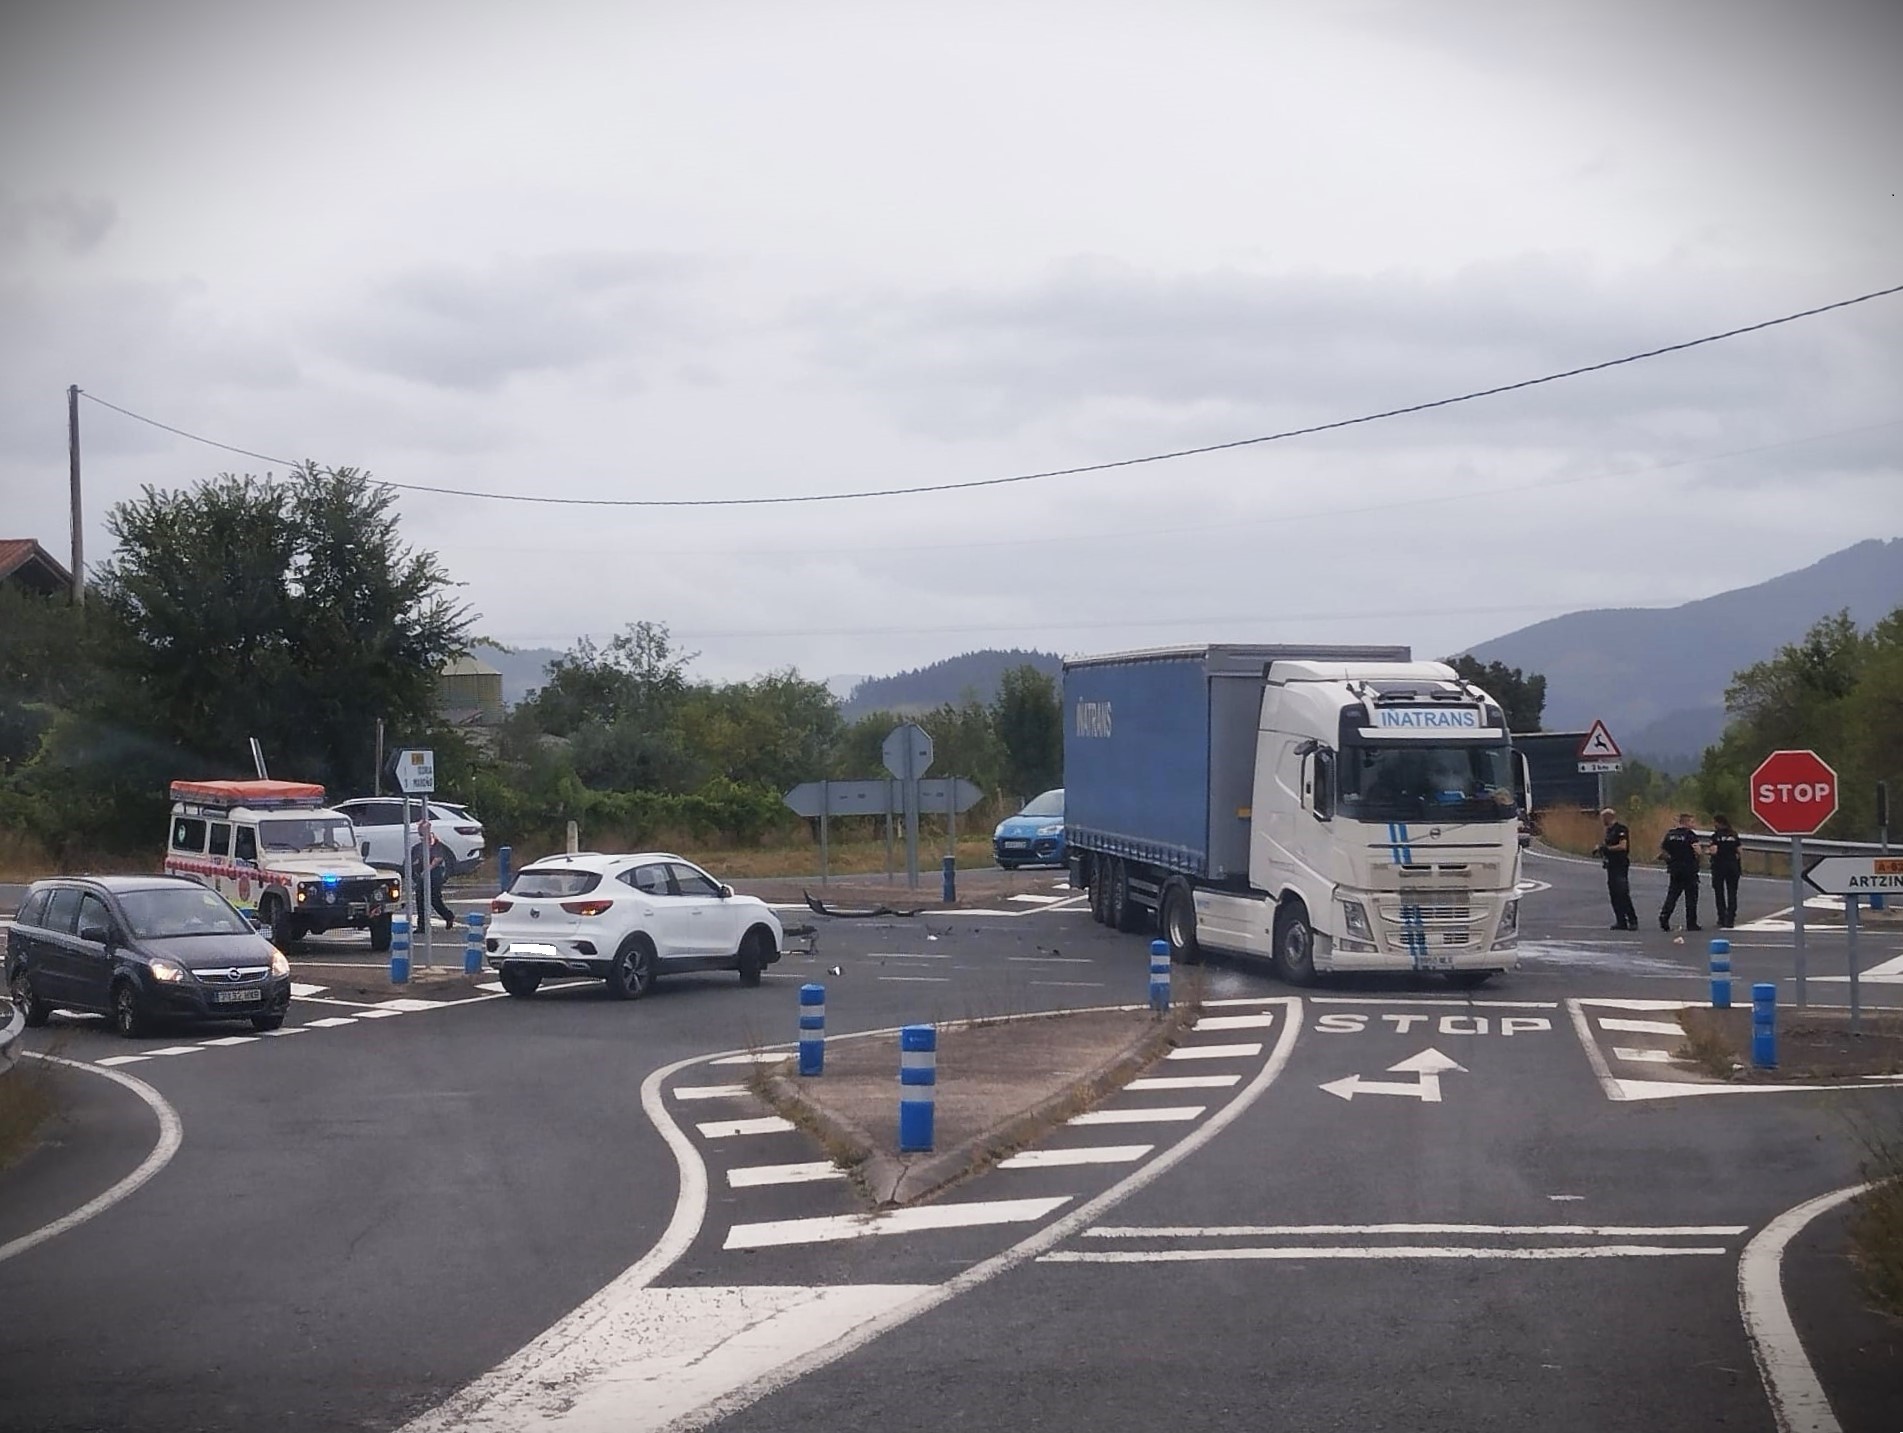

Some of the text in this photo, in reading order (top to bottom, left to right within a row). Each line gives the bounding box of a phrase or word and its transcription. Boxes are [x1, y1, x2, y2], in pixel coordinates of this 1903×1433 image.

[1381, 708, 1475, 727] IÑATRANS
[1759, 783, 1830, 803] STOP
[1849, 875, 1903, 888] ARTZIN
[1314, 1013, 1552, 1036] STOP
